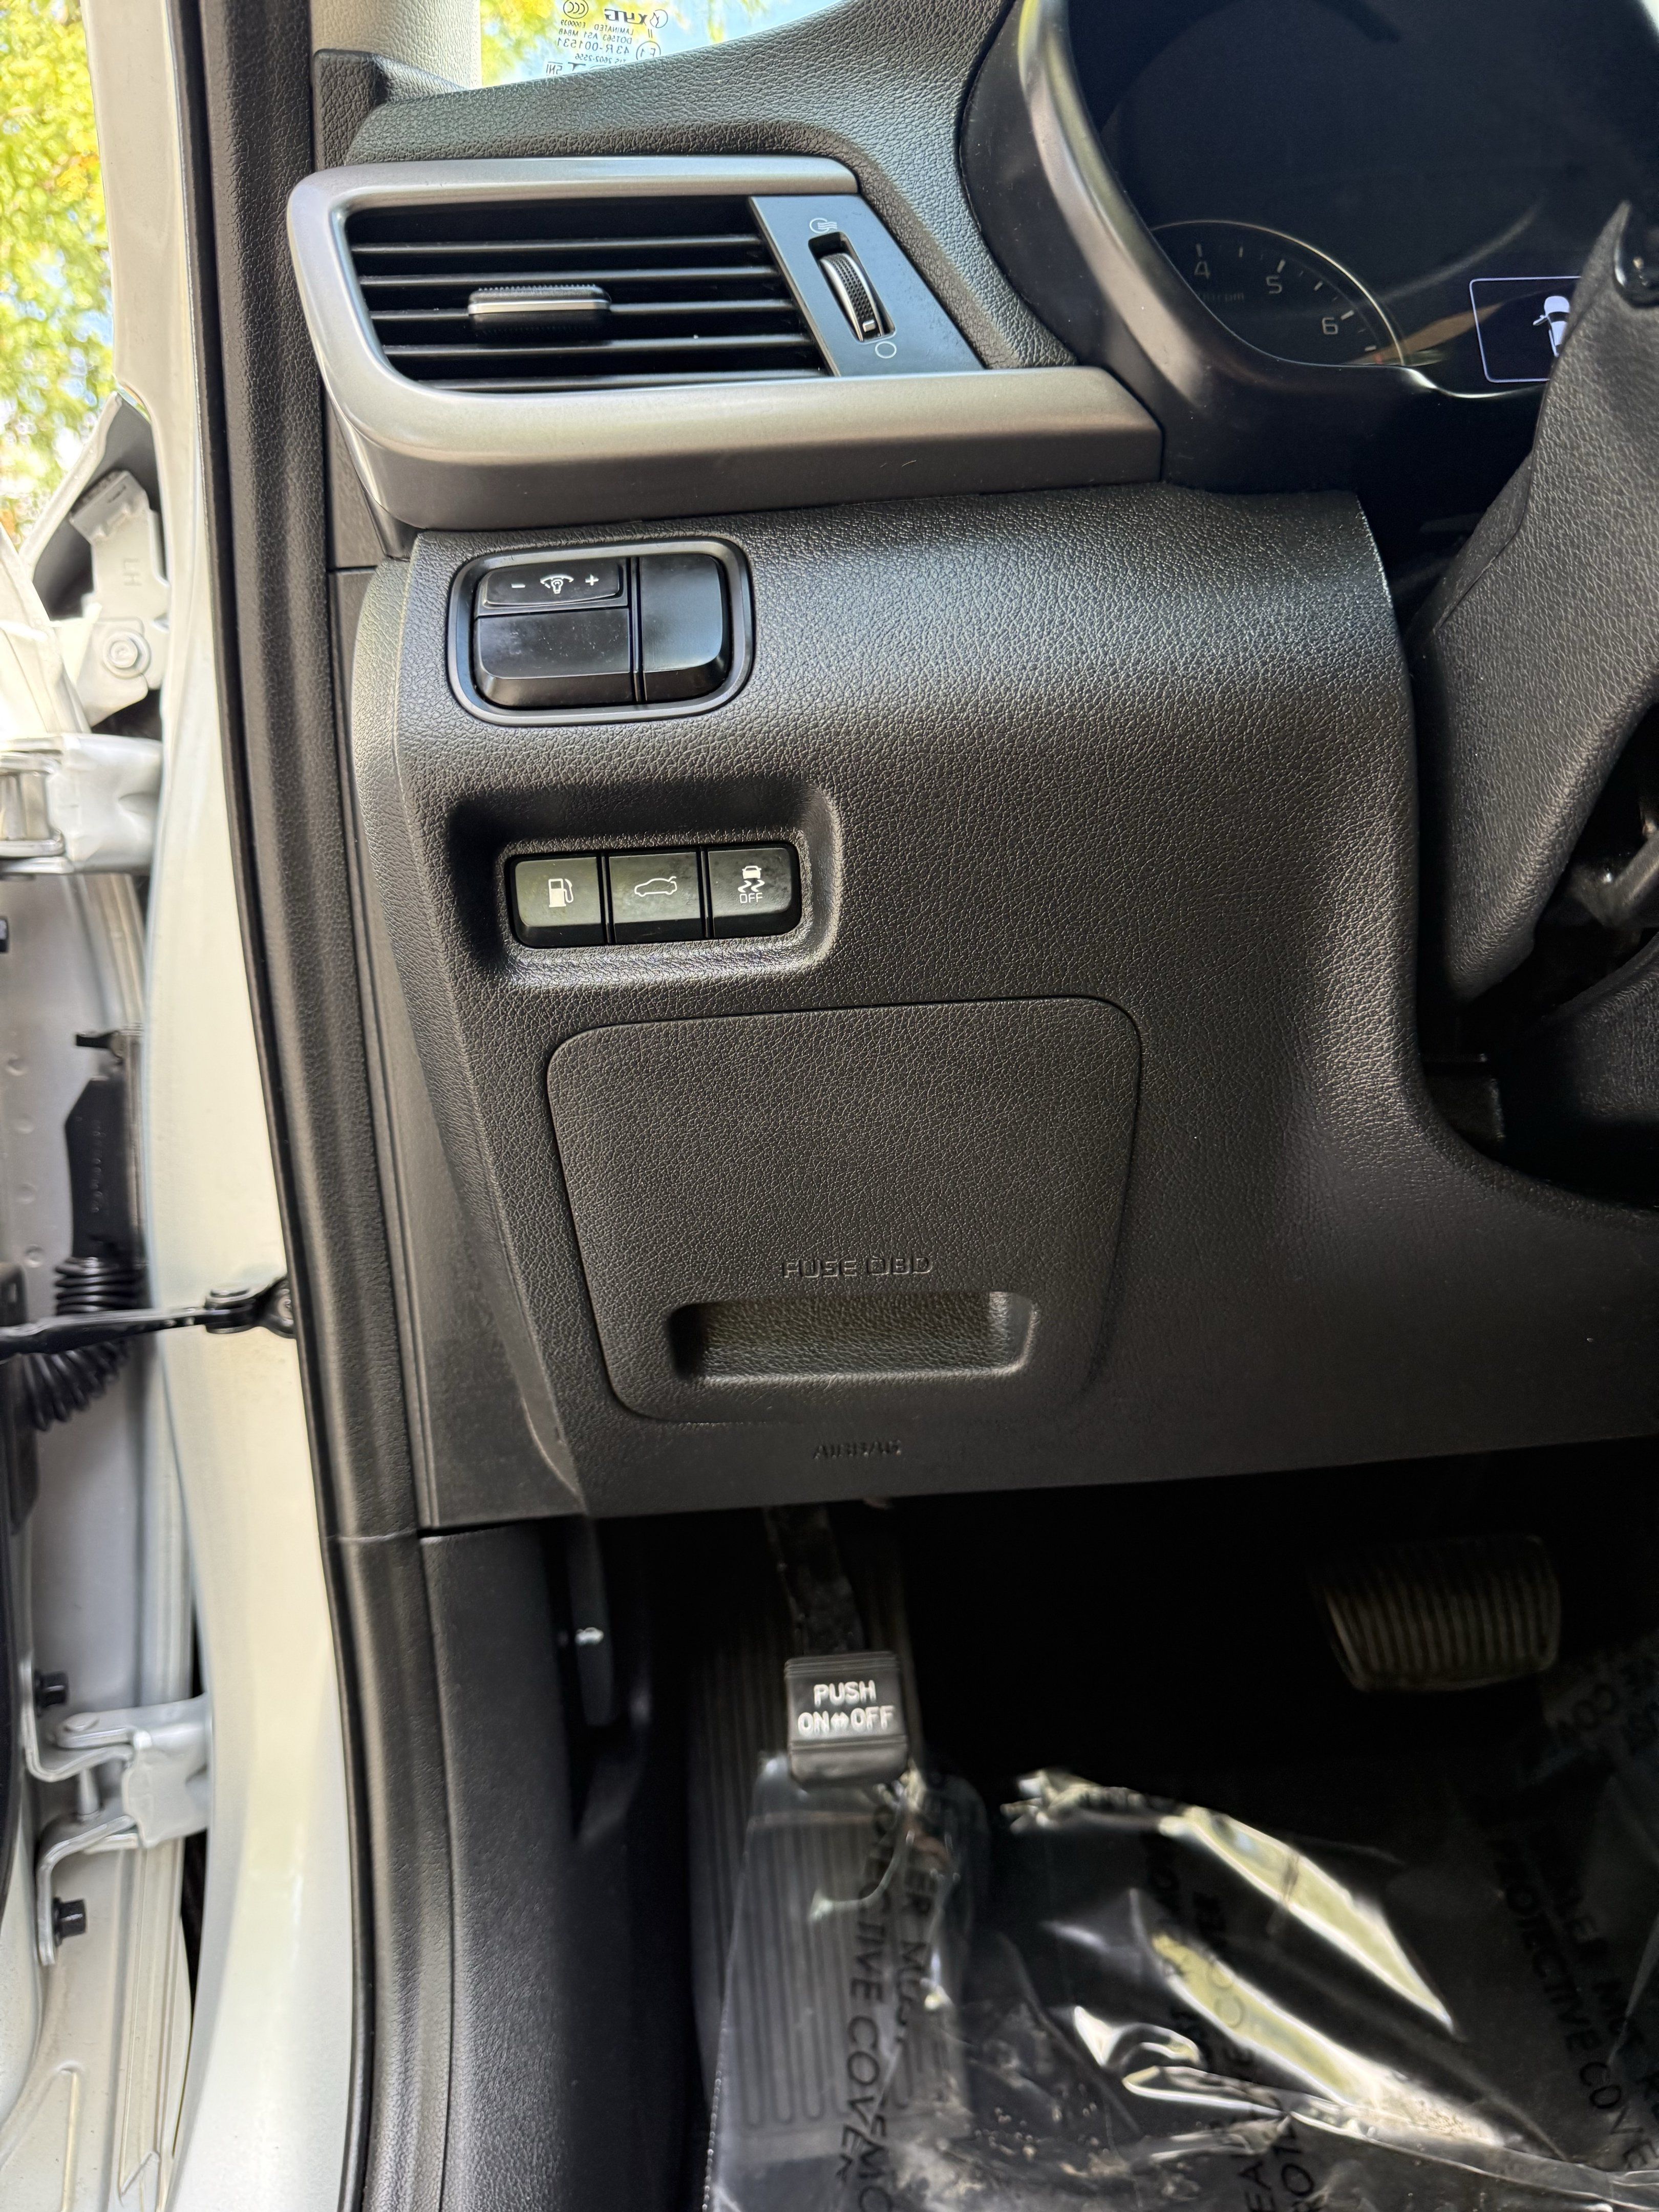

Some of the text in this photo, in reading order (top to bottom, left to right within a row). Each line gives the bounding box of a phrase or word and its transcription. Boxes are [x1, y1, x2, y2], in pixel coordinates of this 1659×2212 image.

[1194, 260, 1210, 280] 4
[1265, 273, 1283, 295] 5
[1321, 315, 1339, 335] 6
[739, 892, 763, 904] OFF
[781, 1255, 933, 1279] FUSE OBD
[813, 1679, 877, 1708] PUSH
[798, 1705, 895, 1737] ON OFF
